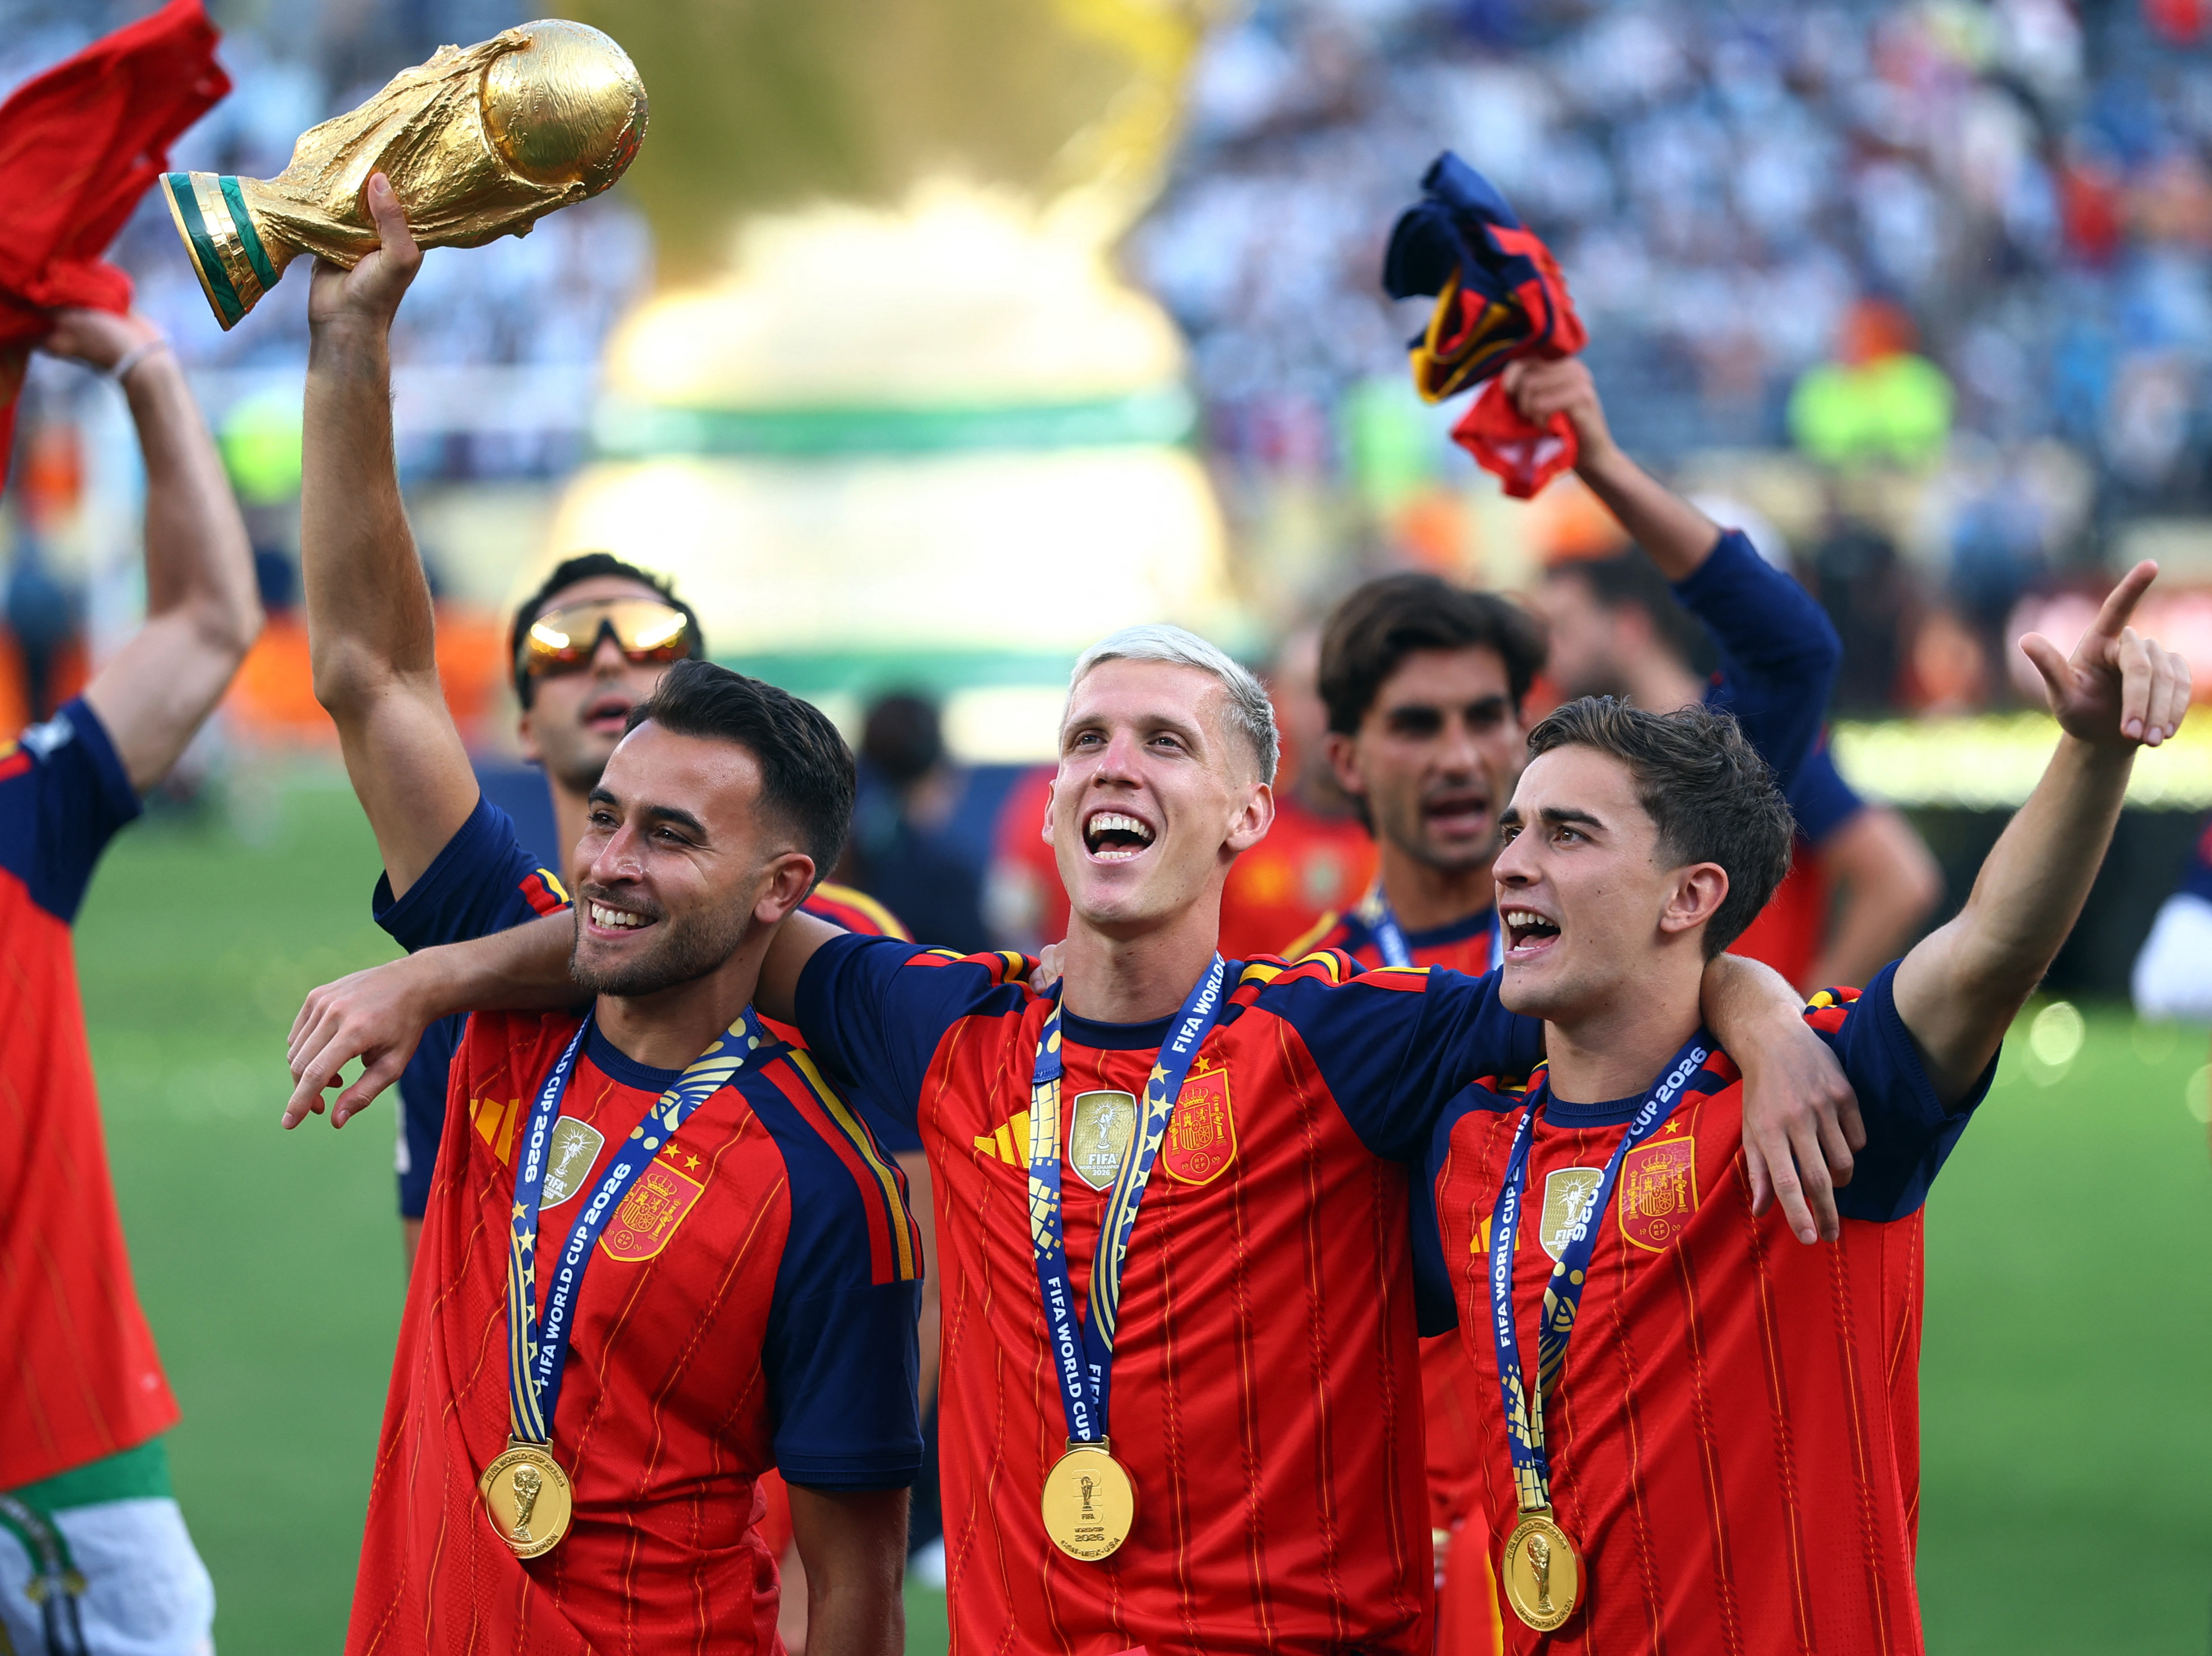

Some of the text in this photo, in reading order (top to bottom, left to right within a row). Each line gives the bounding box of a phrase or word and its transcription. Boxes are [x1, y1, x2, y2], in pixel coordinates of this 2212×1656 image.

[1171, 963, 1224, 1053] FIFA WORLD
[541, 1076, 560, 1112] CUP
[1630, 1047, 1707, 1136] CUP 2026
[525, 1115, 548, 1183] 2026
[1088, 1153, 1117, 1164] FIFA
[542, 1189, 554, 1200] 2026
[544, 1173, 566, 1192] FIFA
[1503, 1186, 1516, 1224] CUP
[1555, 1229, 1574, 1240] FIF
[539, 1163, 631, 1386] FIFA WORLD CUP 2026
[1495, 1227, 1510, 1301] WORLD
[1498, 1301, 1511, 1347] FIFA
[1047, 1276, 1091, 1441] FIFA WORLD CUP
[1089, 1364, 1101, 1404] FIFA
[485, 1464, 500, 1482] FIFA
[499, 1452, 527, 1466] WORLD
[514, 1531, 559, 1555] CHAMPION
[1074, 1534, 1105, 1542] 2026
